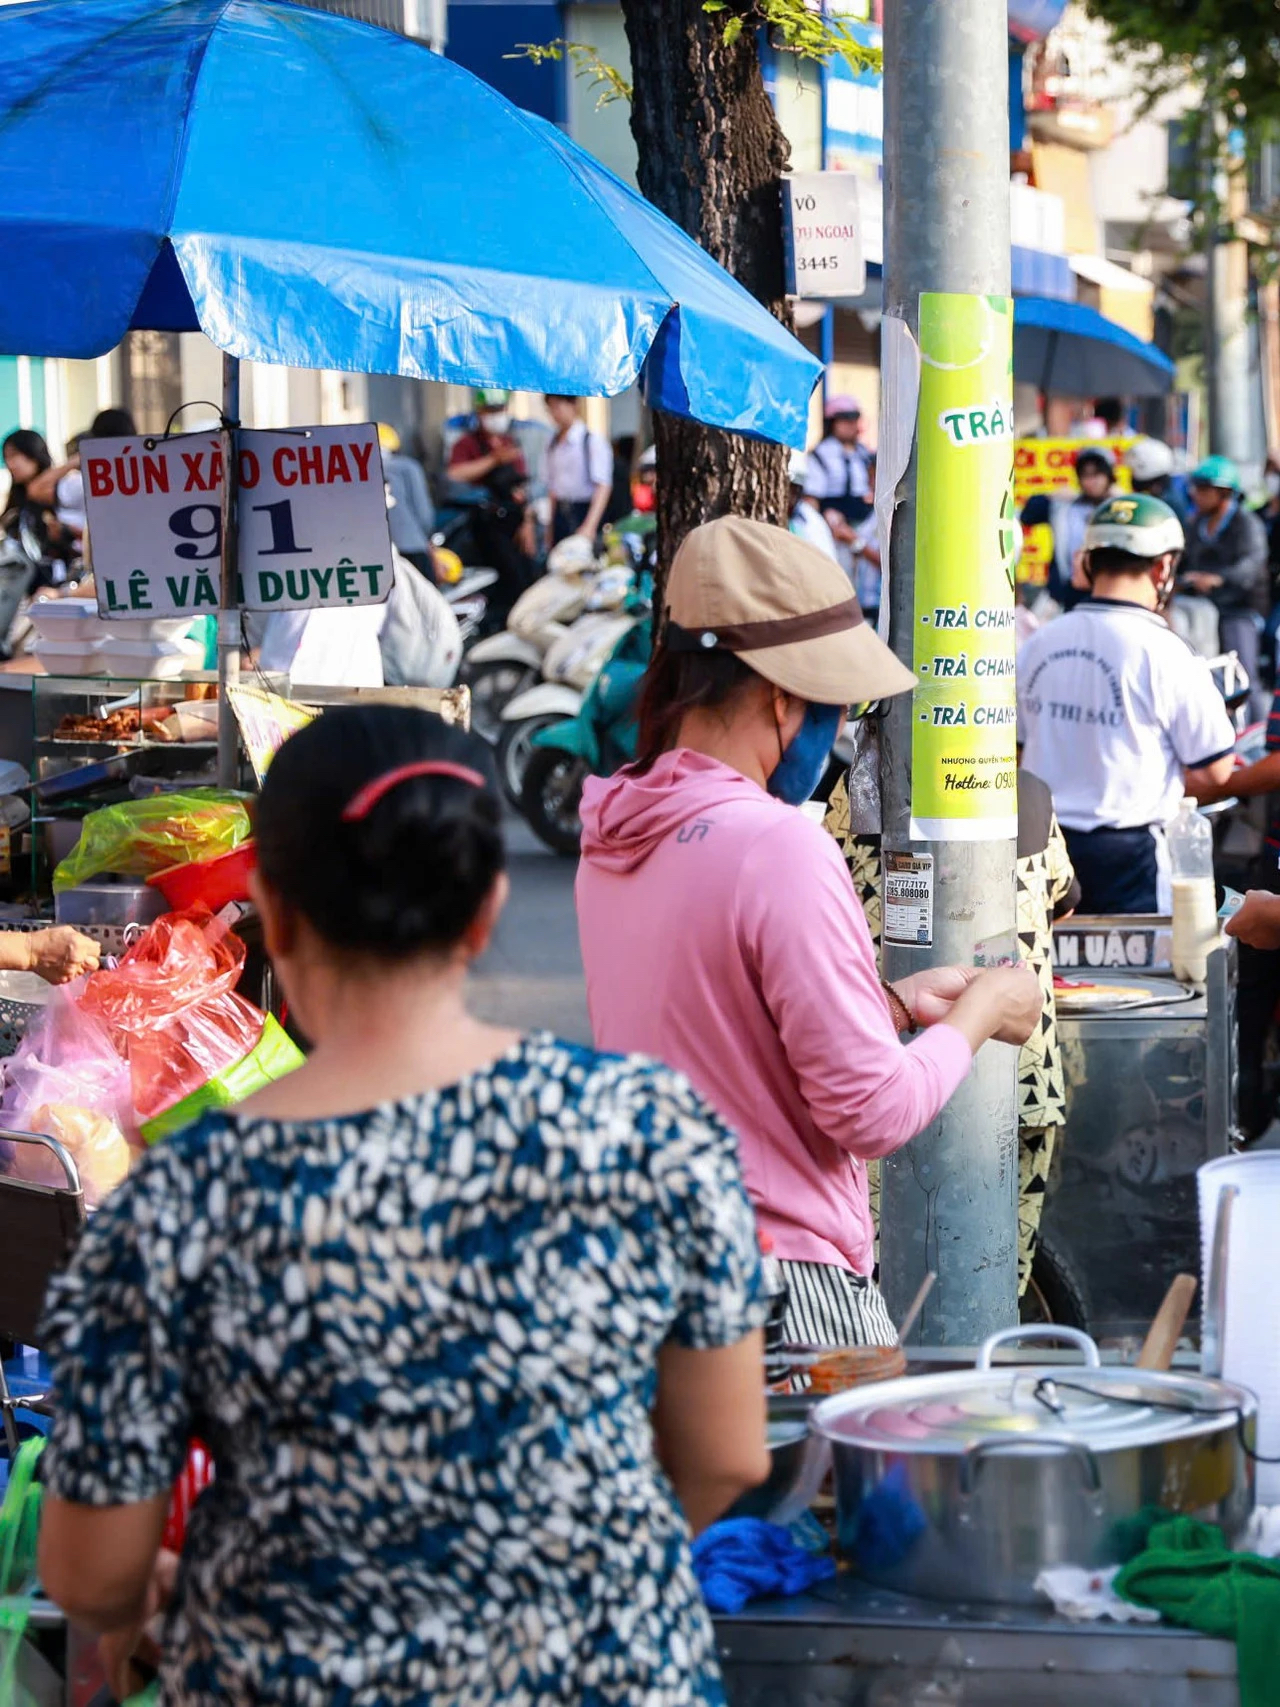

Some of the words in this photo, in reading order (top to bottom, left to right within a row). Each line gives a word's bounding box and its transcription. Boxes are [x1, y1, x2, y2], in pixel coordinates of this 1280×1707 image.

[797, 255, 838, 271] 3445
[944, 401, 1004, 441] TRÀ
[87, 445, 169, 498] BÚN
[181, 441, 260, 493] XÀO
[272, 442, 374, 487] CHAY
[168, 499, 313, 561] 91
[105, 569, 153, 612] LÊ
[258, 557, 384, 605] DUYỆT
[934, 605, 968, 629] TRÀ
[933, 653, 967, 677] TRÀ
[932, 702, 967, 725] TRÀ
[941, 756, 976, 767] NHƯỢNG
[944, 773, 991, 791] Hotline:
